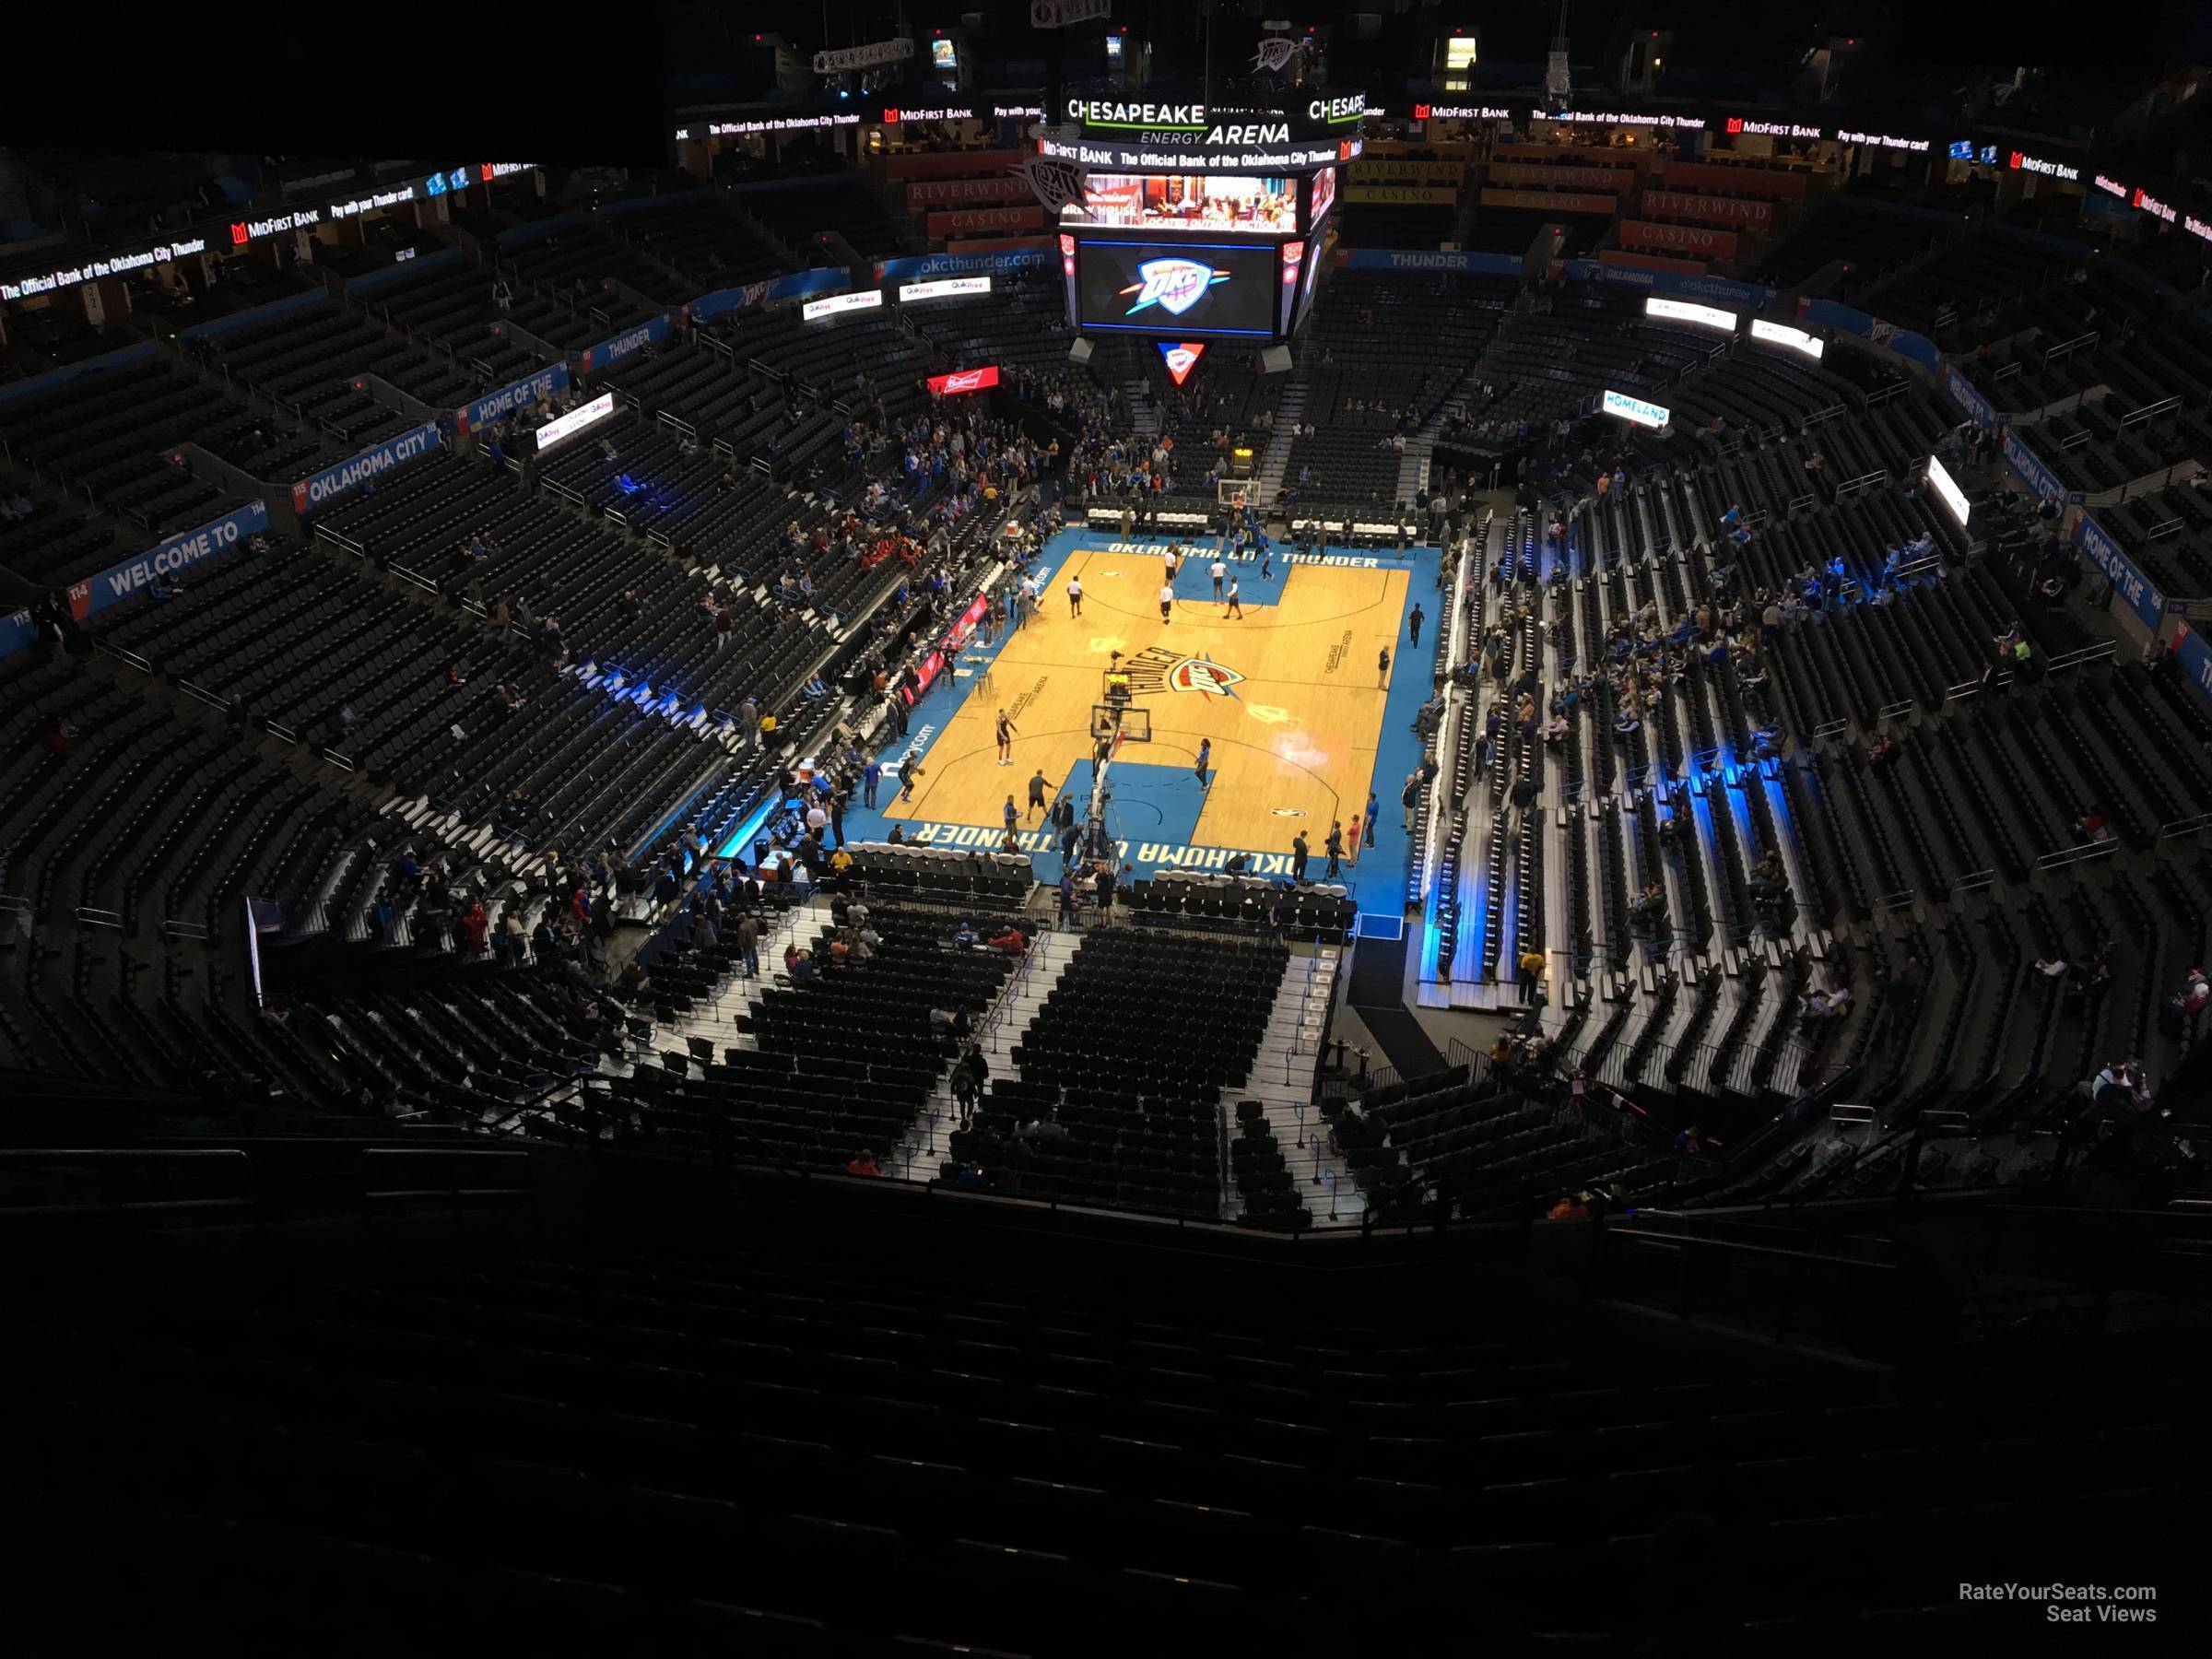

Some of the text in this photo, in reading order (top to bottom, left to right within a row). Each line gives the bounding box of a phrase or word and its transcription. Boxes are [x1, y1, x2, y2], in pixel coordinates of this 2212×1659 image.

[947, 108, 972, 119] BANK
[994, 107, 1007, 118] Pay
[1008, 107, 1024, 116] with
[1068, 99, 1205, 124] CHESAPEAKE
[1482, 107, 1509, 119] BANK
[1533, 110, 1546, 120] The
[1575, 112, 1595, 122] Bank
[1596, 112, 1606, 123] of
[1606, 113, 1618, 123] the
[1619, 113, 1659, 125] Oklahoma
[1660, 115, 1675, 127] City
[1676, 117, 1706, 128] Thunder
[709, 113, 860, 135] The Official Bank of the Oklahoma City Thunder
[1792, 125, 1821, 138] BANK
[1140, 124, 1289, 145] ENERGY ARENA
[1838, 130, 1930, 151] Pay with your Thunder card!
[1079, 147, 1112, 164] BANK
[1121, 149, 1336, 167] The Official Bank of the Oklahoma City Thunder
[1354, 163, 1458, 176] RIVERWIND
[2056, 164, 2079, 181] BANK
[912, 182, 1029, 200] RIVERWIND
[1367, 190, 1433, 201] CASINO
[331, 205, 344, 218] Pay
[344, 201, 359, 214] with
[358, 197, 372, 214] your
[372, 191, 397, 207] Thunder
[1647, 194, 1767, 219] RIVERWIND
[293, 210, 319, 228] BANK
[952, 212, 1021, 228] CASINO
[1642, 227, 1713, 247] CASINO
[1, 238, 205, 300] The Official Bank of the Oklahoma City Thunder
[921, 253, 1045, 274] okcthunder.com
[1391, 253, 1468, 267] THUNDER
[608, 328, 651, 359] THUNDER
[479, 392, 513, 421] HOME
[514, 383, 530, 404] OF
[530, 373, 553, 396] THE
[1606, 394, 1666, 420] HOMELAND
[310, 450, 394, 501] OKLAHOMA
[395, 431, 426, 461] CITY
[69, 501, 266, 601] 114 WELCOME TO 114
[1282, 552, 1378, 568] THUNDER
[2084, 526, 2112, 571] HOME
[2110, 556, 2125, 582] OF
[2124, 569, 2144, 606] THE
[13, 609, 30, 628] 113
